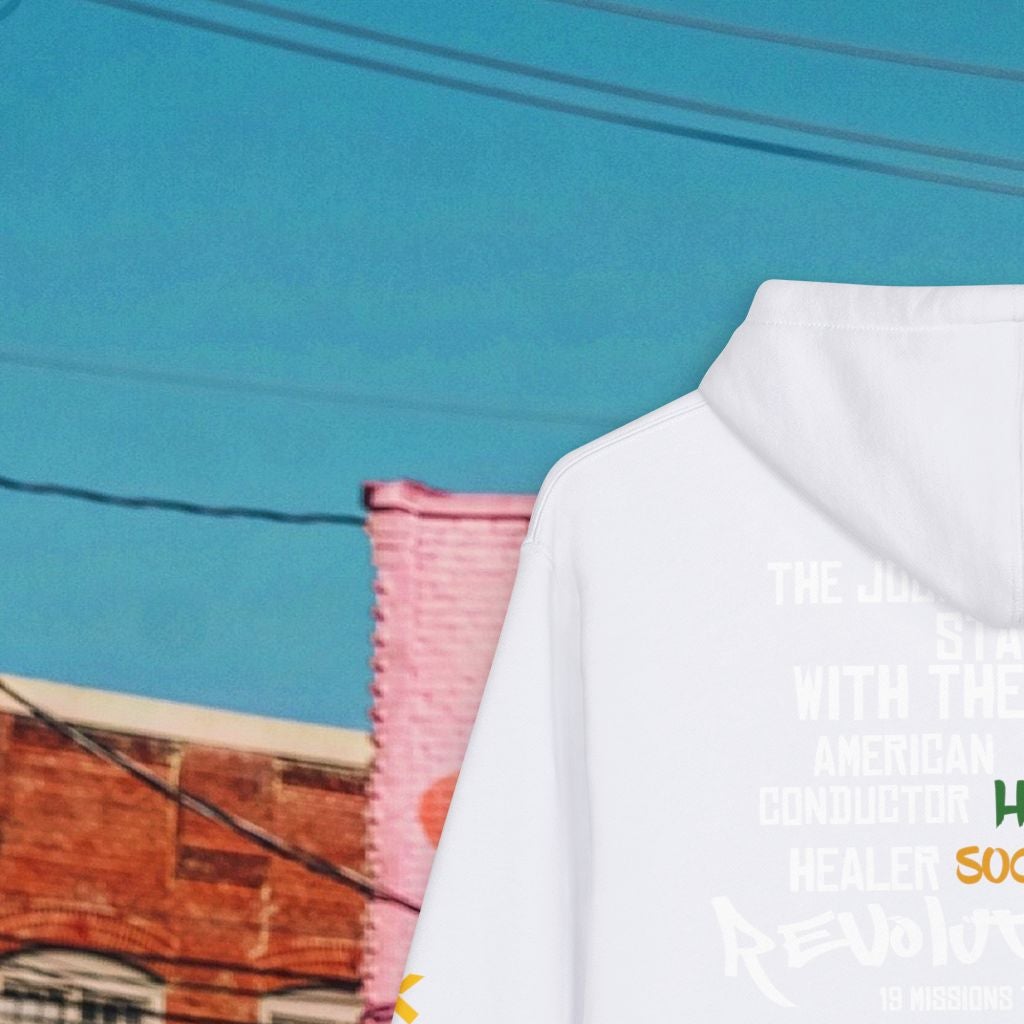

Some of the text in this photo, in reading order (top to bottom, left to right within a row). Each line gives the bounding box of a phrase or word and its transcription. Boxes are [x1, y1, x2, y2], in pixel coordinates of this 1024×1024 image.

[766, 560, 843, 606] THE
[793, 663, 909, 721] WITH
[927, 663, 1024, 720] THE
[813, 733, 995, 777] AMERICAN
[758, 785, 970, 826] CONDUCTOR
[789, 846, 940, 892] HEALER
[879, 986, 904, 1011] 19
[910, 985, 1013, 1011] MISSIONS
